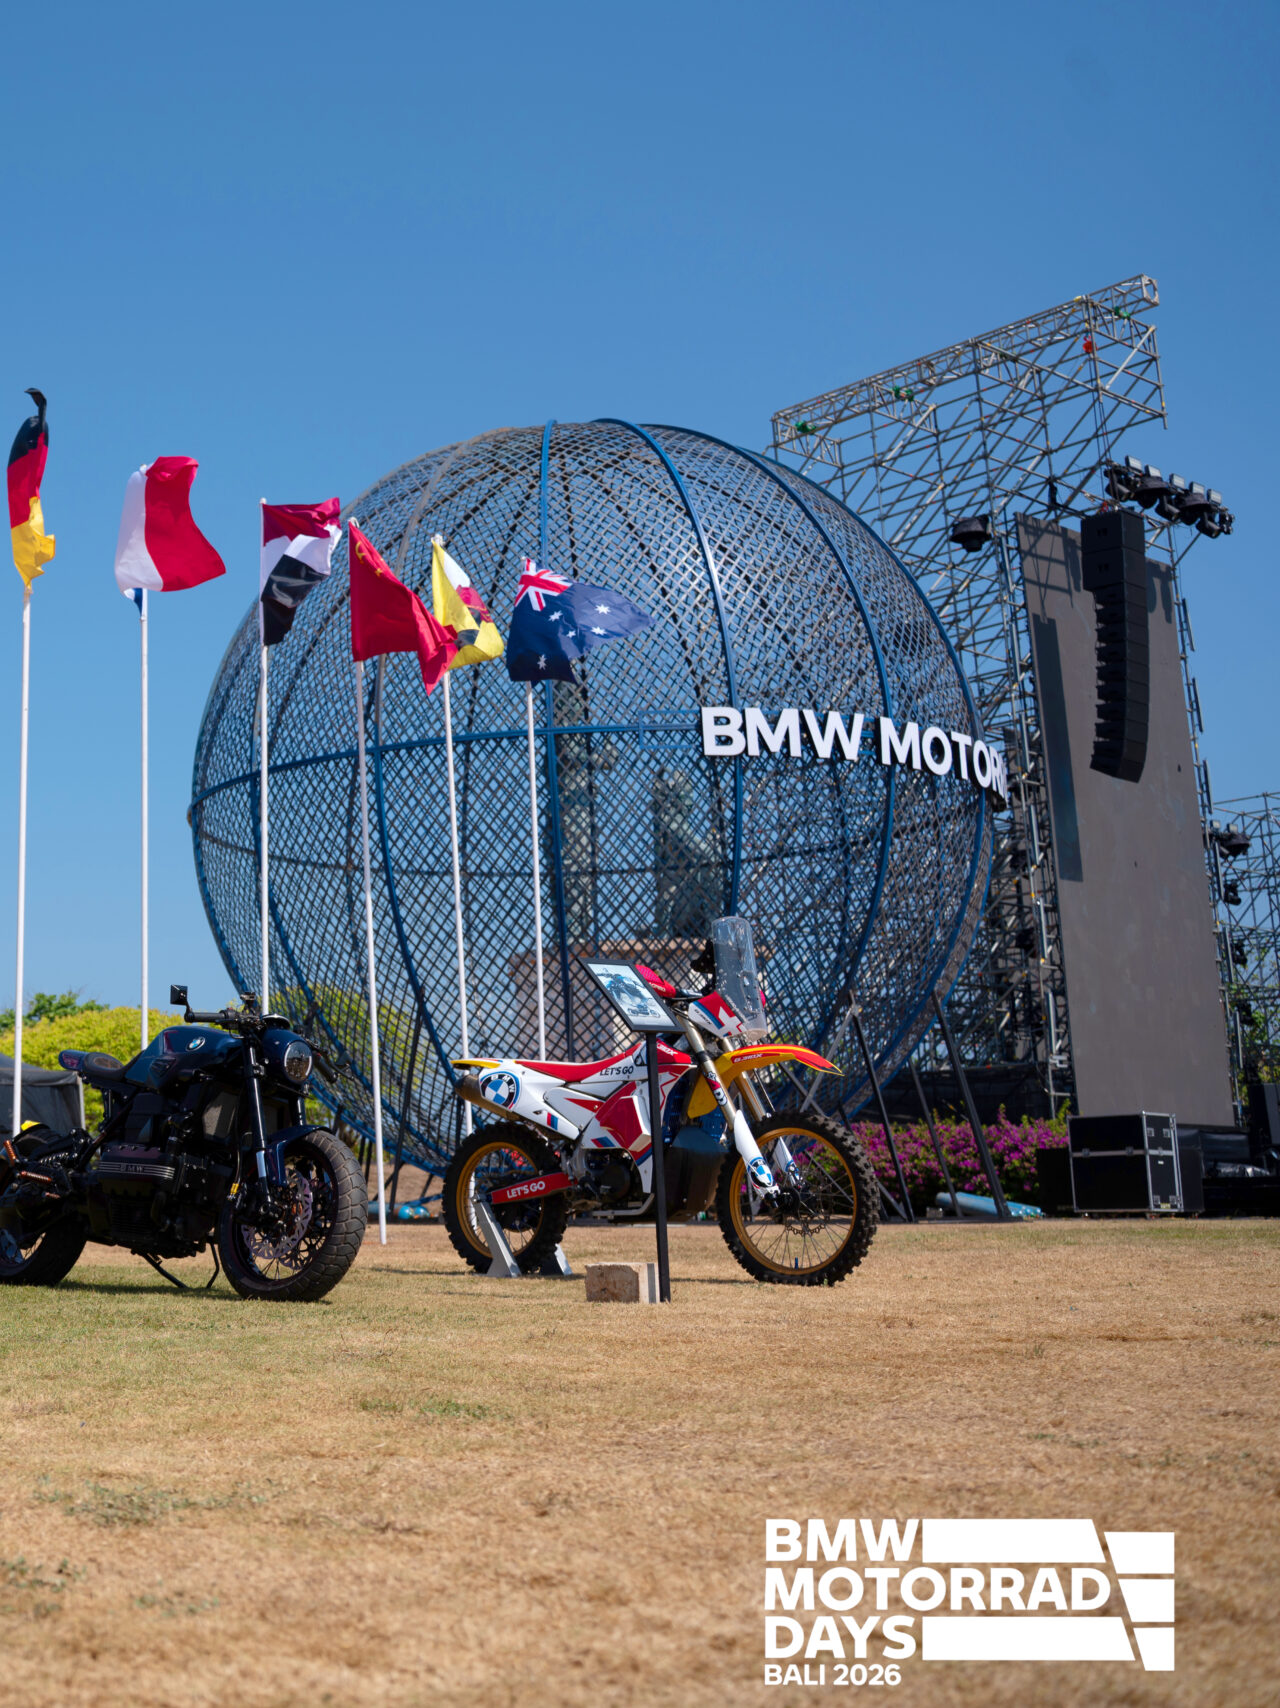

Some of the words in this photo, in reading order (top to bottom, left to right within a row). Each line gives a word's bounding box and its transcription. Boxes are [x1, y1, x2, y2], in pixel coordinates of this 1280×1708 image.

[701, 706, 865, 761] BMW
[622, 1066, 634, 1075] GO
[506, 1185, 530, 1199] LET'S
[530, 1181, 546, 1192] GO
